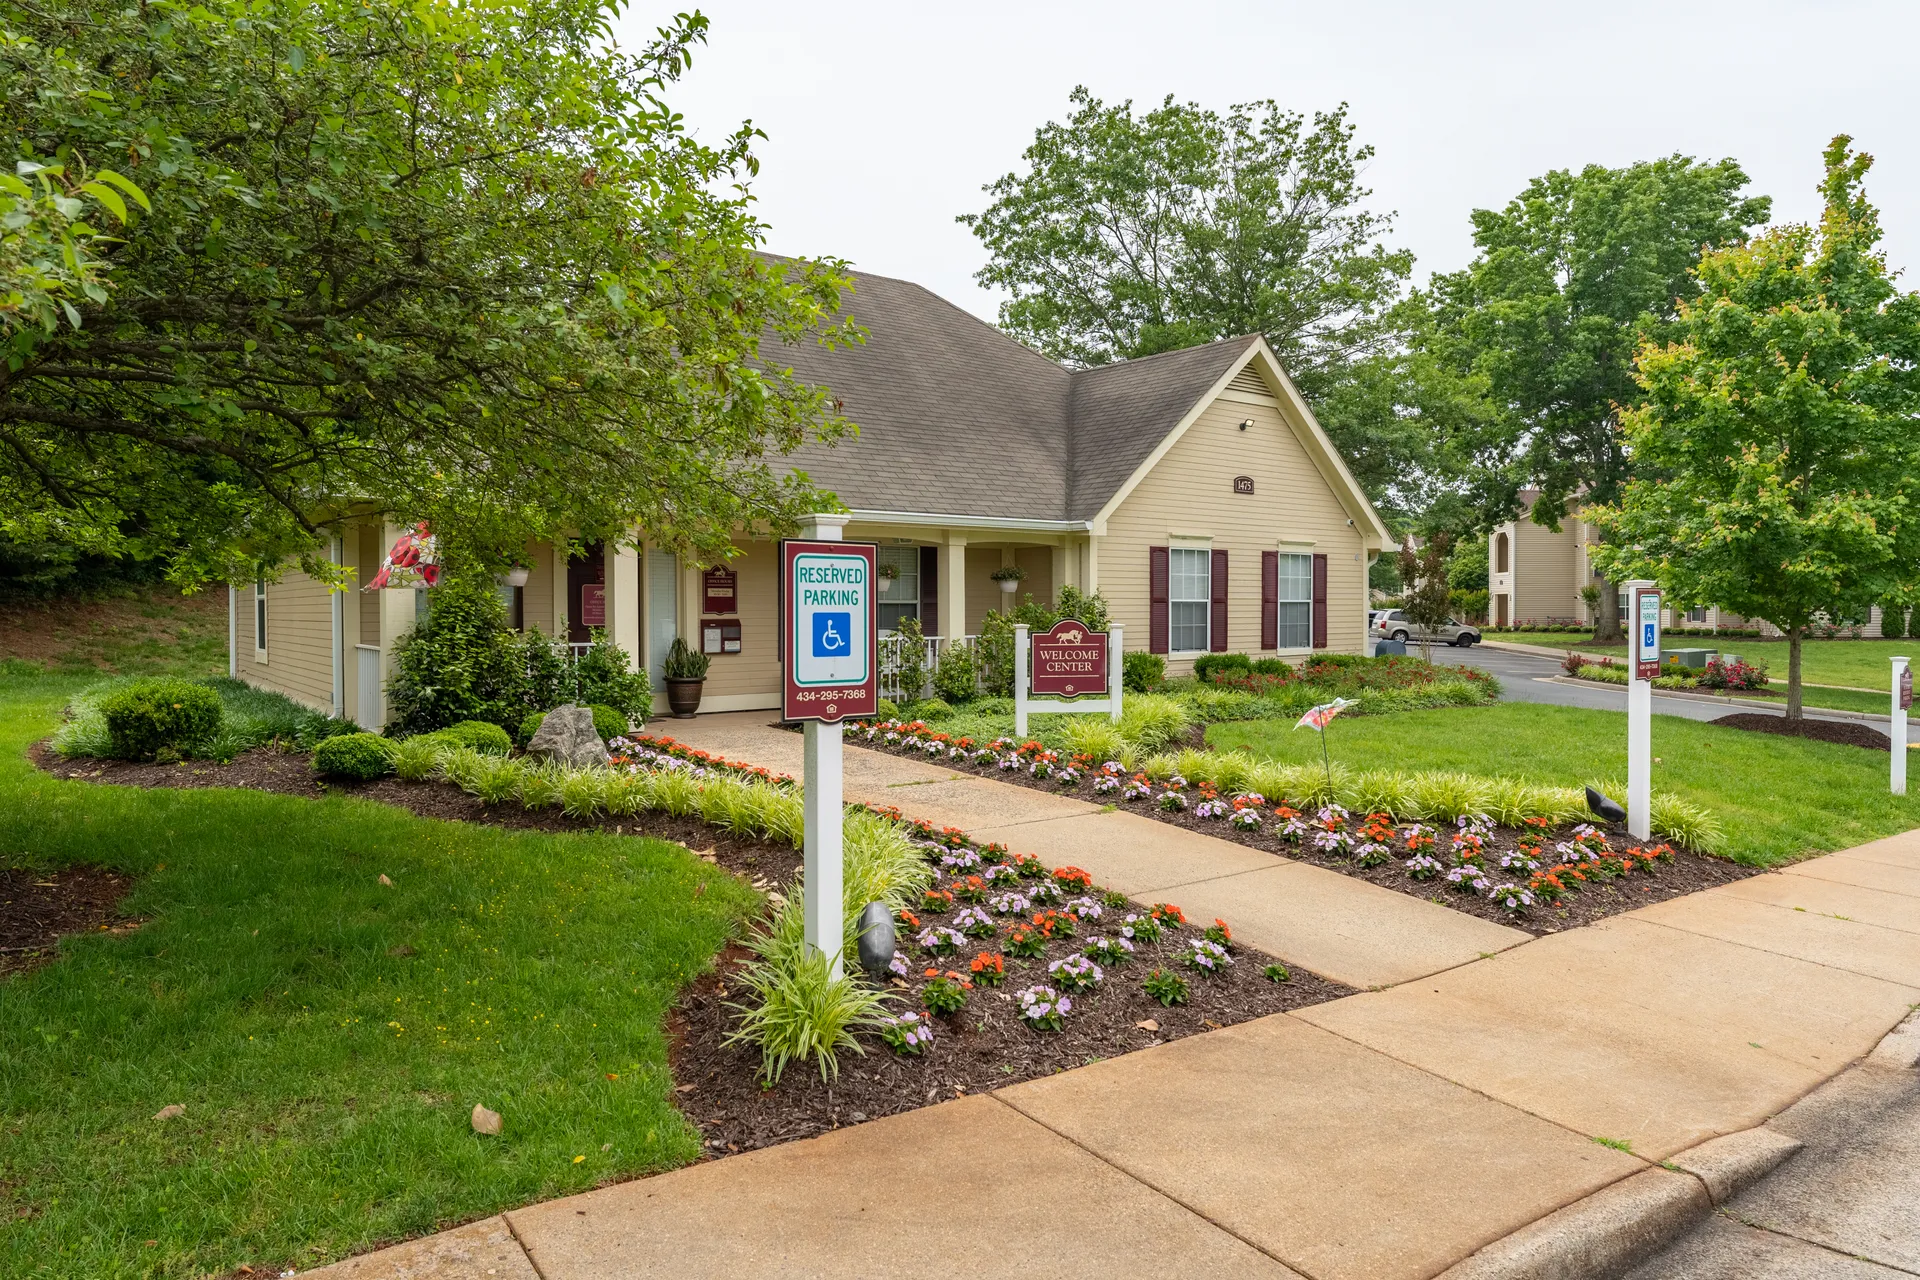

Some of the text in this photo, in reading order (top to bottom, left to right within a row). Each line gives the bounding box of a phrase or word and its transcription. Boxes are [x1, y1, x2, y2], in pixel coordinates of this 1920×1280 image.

[1238, 481, 1251, 490] 1475
[800, 567, 862, 583] RESERVED
[804, 590, 859, 606] PARKING
[1040, 650, 1099, 660] WELCOME
[1047, 661, 1092, 671] CENTER
[796, 689, 866, 701] 434-295-7368
